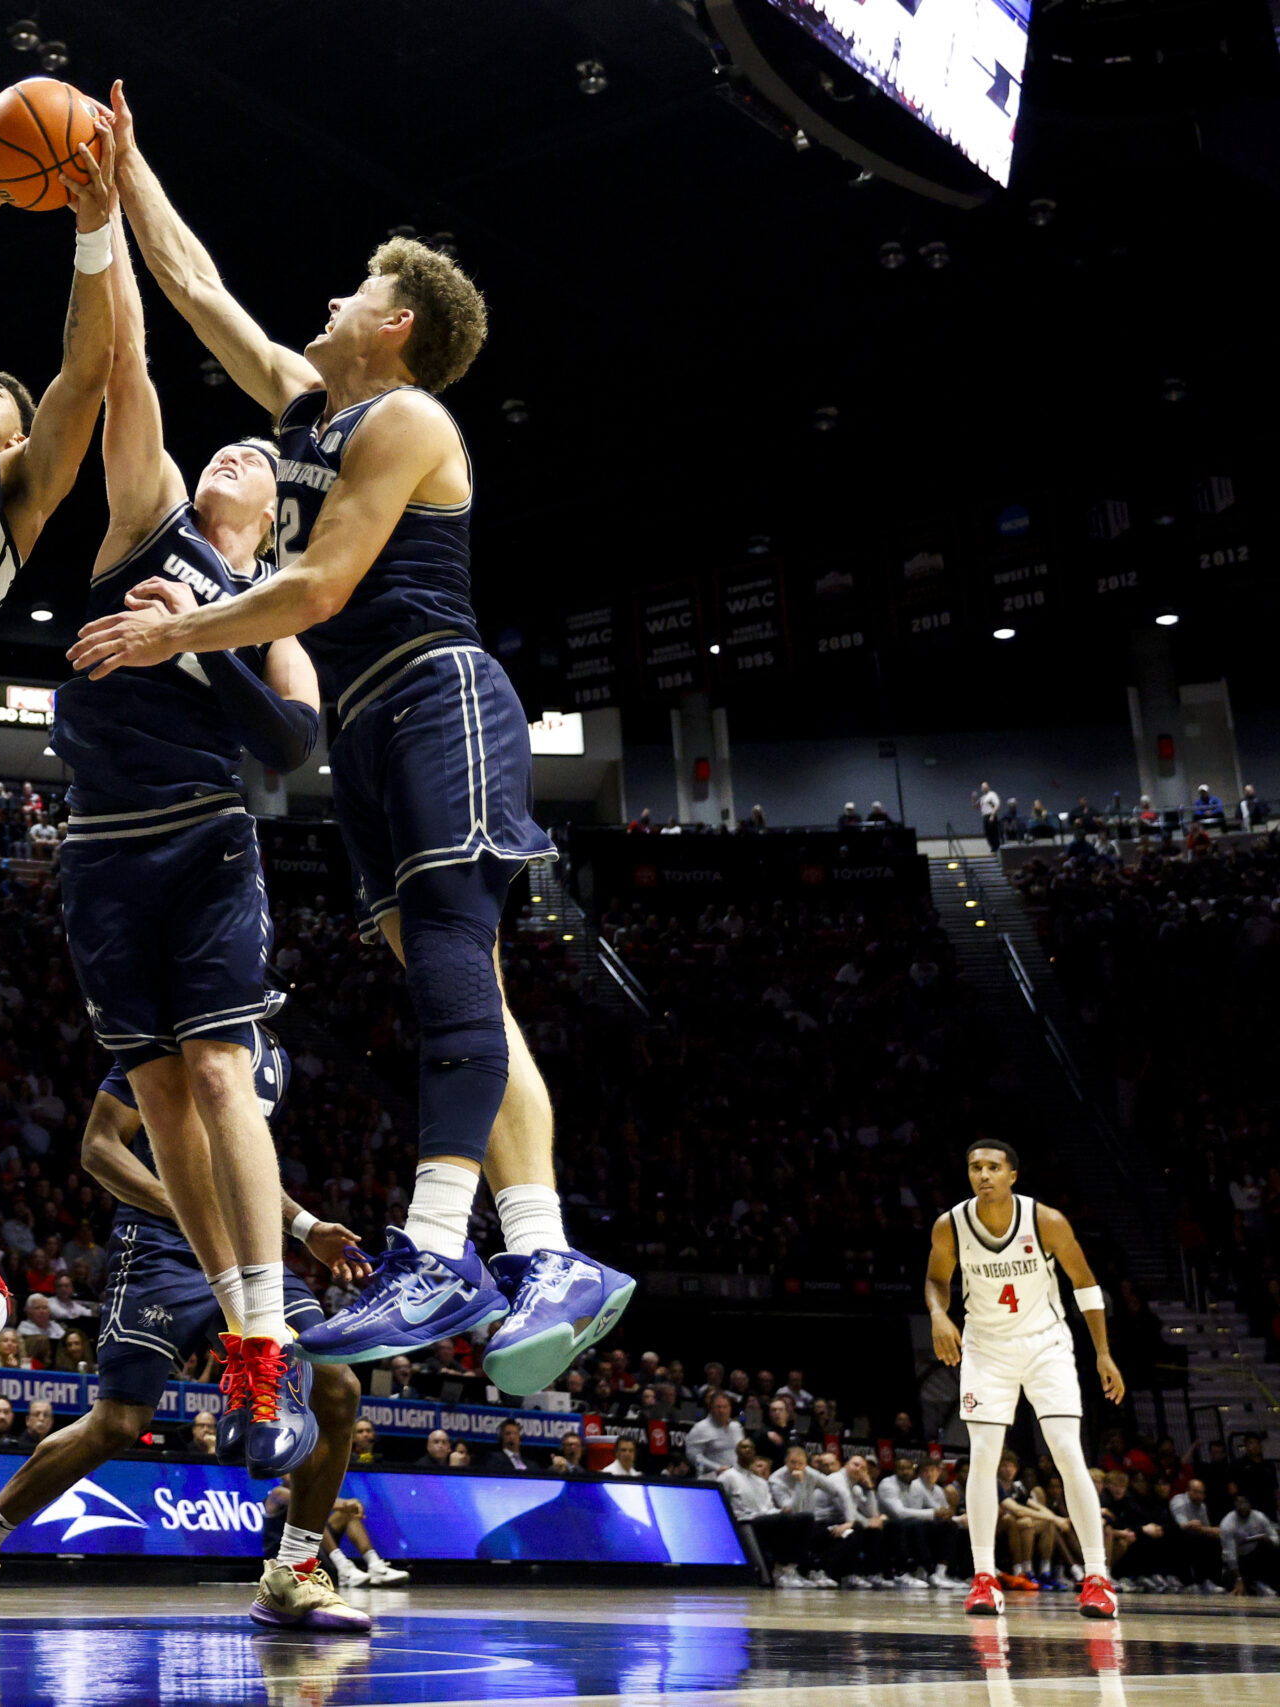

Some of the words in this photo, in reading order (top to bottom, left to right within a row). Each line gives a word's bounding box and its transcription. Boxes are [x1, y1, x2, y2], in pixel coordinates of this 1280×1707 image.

[1199, 544, 1250, 570] 2012
[162, 552, 222, 602] UTAH
[1096, 568, 1139, 594] 2012
[725, 592, 776, 615] WAC
[645, 611, 693, 634] WAC
[566, 628, 613, 649] WAC
[272, 858, 328, 875] TOYOTA
[661, 869, 723, 883] TOYOTA
[832, 866, 896, 880] TOYOTA
[983, 1262, 1012, 1279] DIEGO
[1012, 1259, 1039, 1278] STATE
[998, 1284, 1020, 1314] 4
[23, 1380, 80, 1405] LIGHT
[185, 1392, 221, 1414] BUD
[361, 1405, 393, 1426] BUD
[394, 1408, 436, 1429] LIGHT
[441, 1411, 470, 1432] BUD
